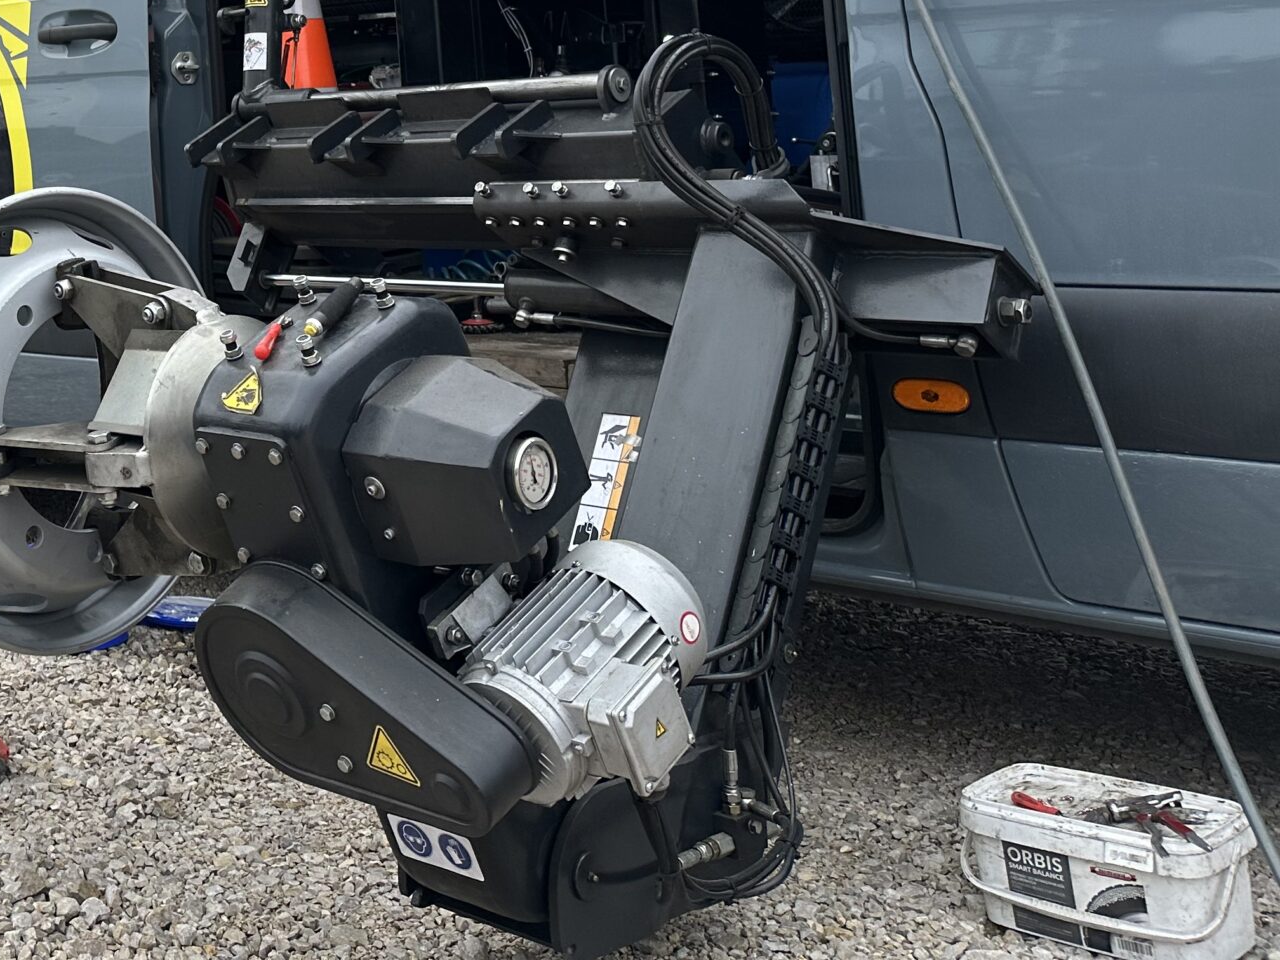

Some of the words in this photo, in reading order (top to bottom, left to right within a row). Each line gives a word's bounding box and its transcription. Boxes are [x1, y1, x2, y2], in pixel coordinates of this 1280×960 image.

[1007, 846, 1063, 873] ORBIS
[1008, 861, 1032, 873] SMART
[1032, 868, 1065, 882] BALANCE
